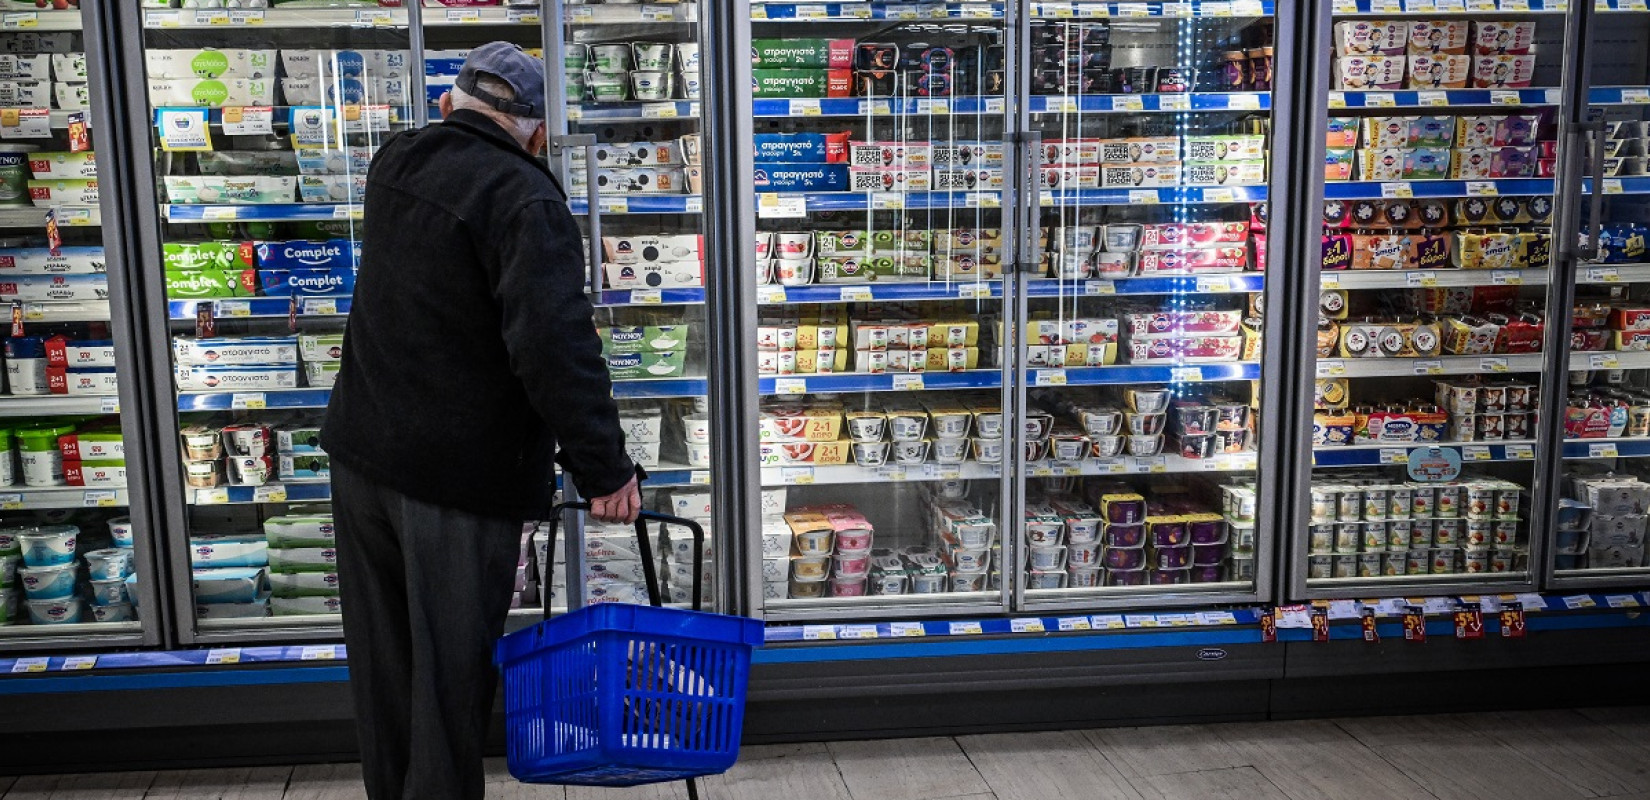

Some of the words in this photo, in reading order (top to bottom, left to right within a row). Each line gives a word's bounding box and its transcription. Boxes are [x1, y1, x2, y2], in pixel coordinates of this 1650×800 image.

[386, 54, 402, 62] 2+1
[761, 140, 813, 151] στραγγιστό
[772, 170, 824, 181] στραγγιστό
[162, 249, 215, 264] Complet
[282, 246, 340, 262] Complet
[1374, 246, 1399, 257] smart
[1485, 245, 1511, 256] smart
[1321, 252, 1346, 265] δώρο!
[1418, 251, 1444, 264] δώρο!
[286, 274, 342, 290] Complet
[813, 422, 831, 432] 2+1
[821, 446, 839, 456] 2+1
[1454, 611, 1472, 628] -5%
[1499, 610, 1517, 626] -5%
